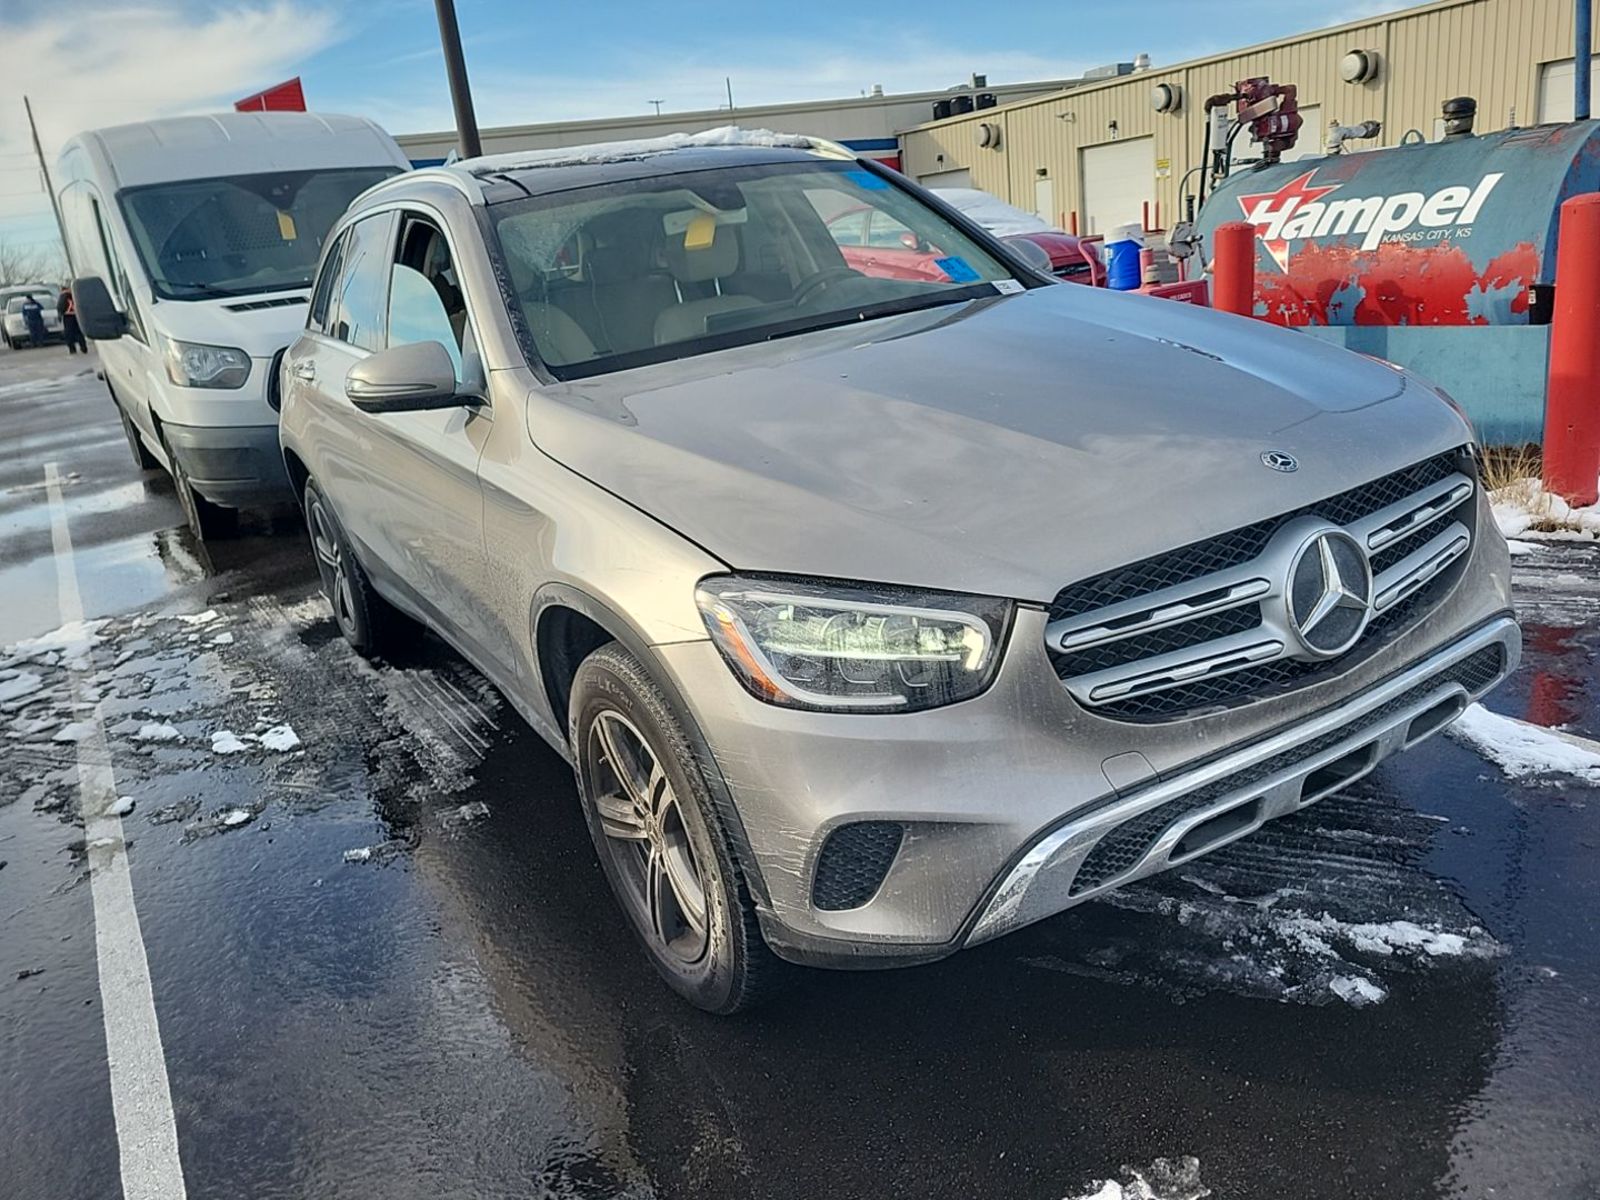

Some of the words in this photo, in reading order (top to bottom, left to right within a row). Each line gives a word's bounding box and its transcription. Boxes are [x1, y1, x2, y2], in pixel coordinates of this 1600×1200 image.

[1245, 173, 1504, 251] Hampel
[1381, 231, 1424, 243] KANSAS
[1426, 229, 1453, 240] CITY,
[1455, 227, 1473, 238] KS
